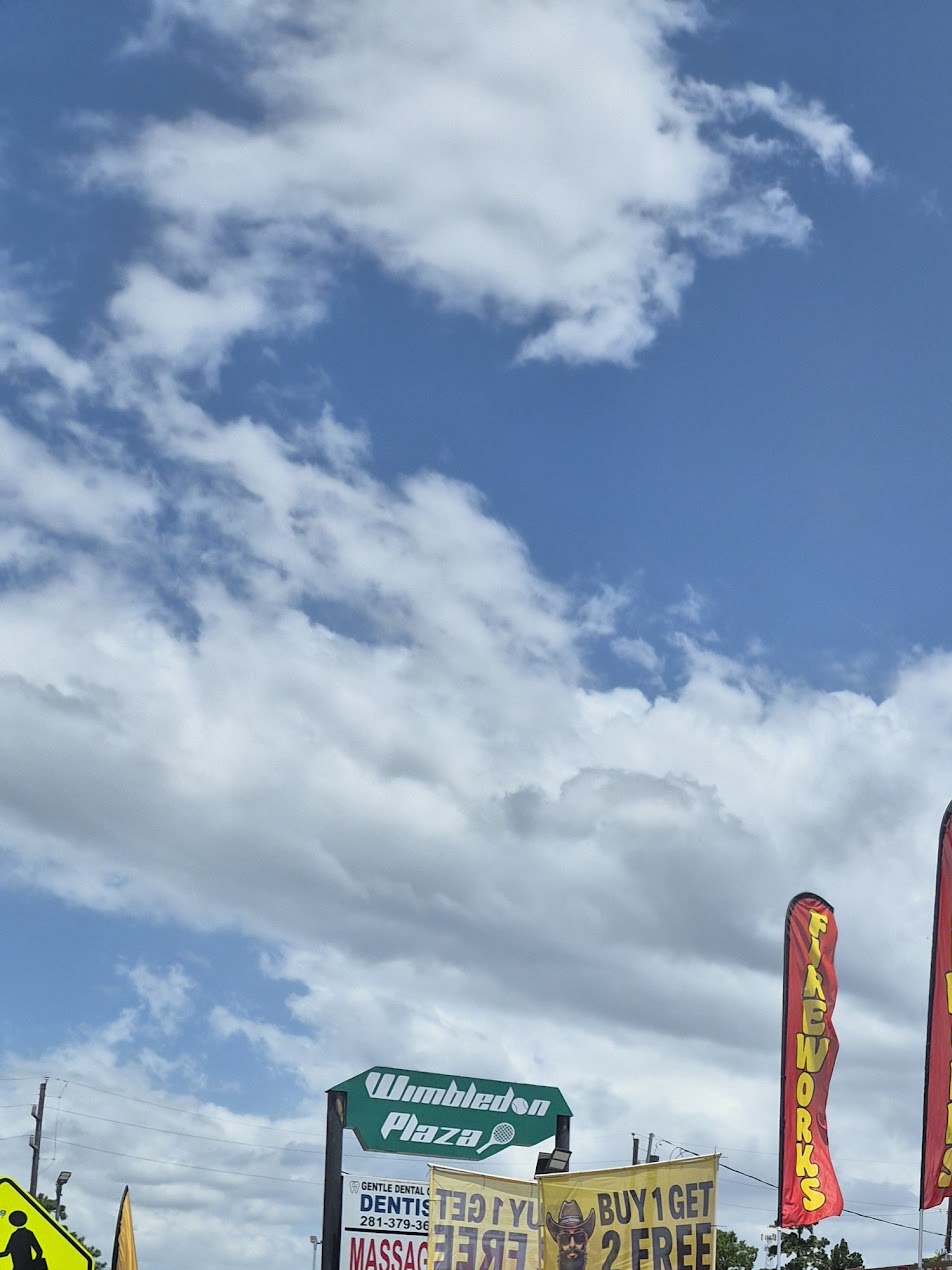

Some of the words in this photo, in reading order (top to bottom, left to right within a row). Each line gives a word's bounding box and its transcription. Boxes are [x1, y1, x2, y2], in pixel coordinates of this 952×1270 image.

[795, 907, 831, 1212] FIREWORKS
[380, 1111, 483, 1148] Plaza
[361, 1182, 393, 1193] GENTLE
[395, 1184, 425, 1196] DENTAL
[597, 1188, 647, 1226] BUY
[652, 1186, 664, 1221] 1
[668, 1180, 714, 1220] GET
